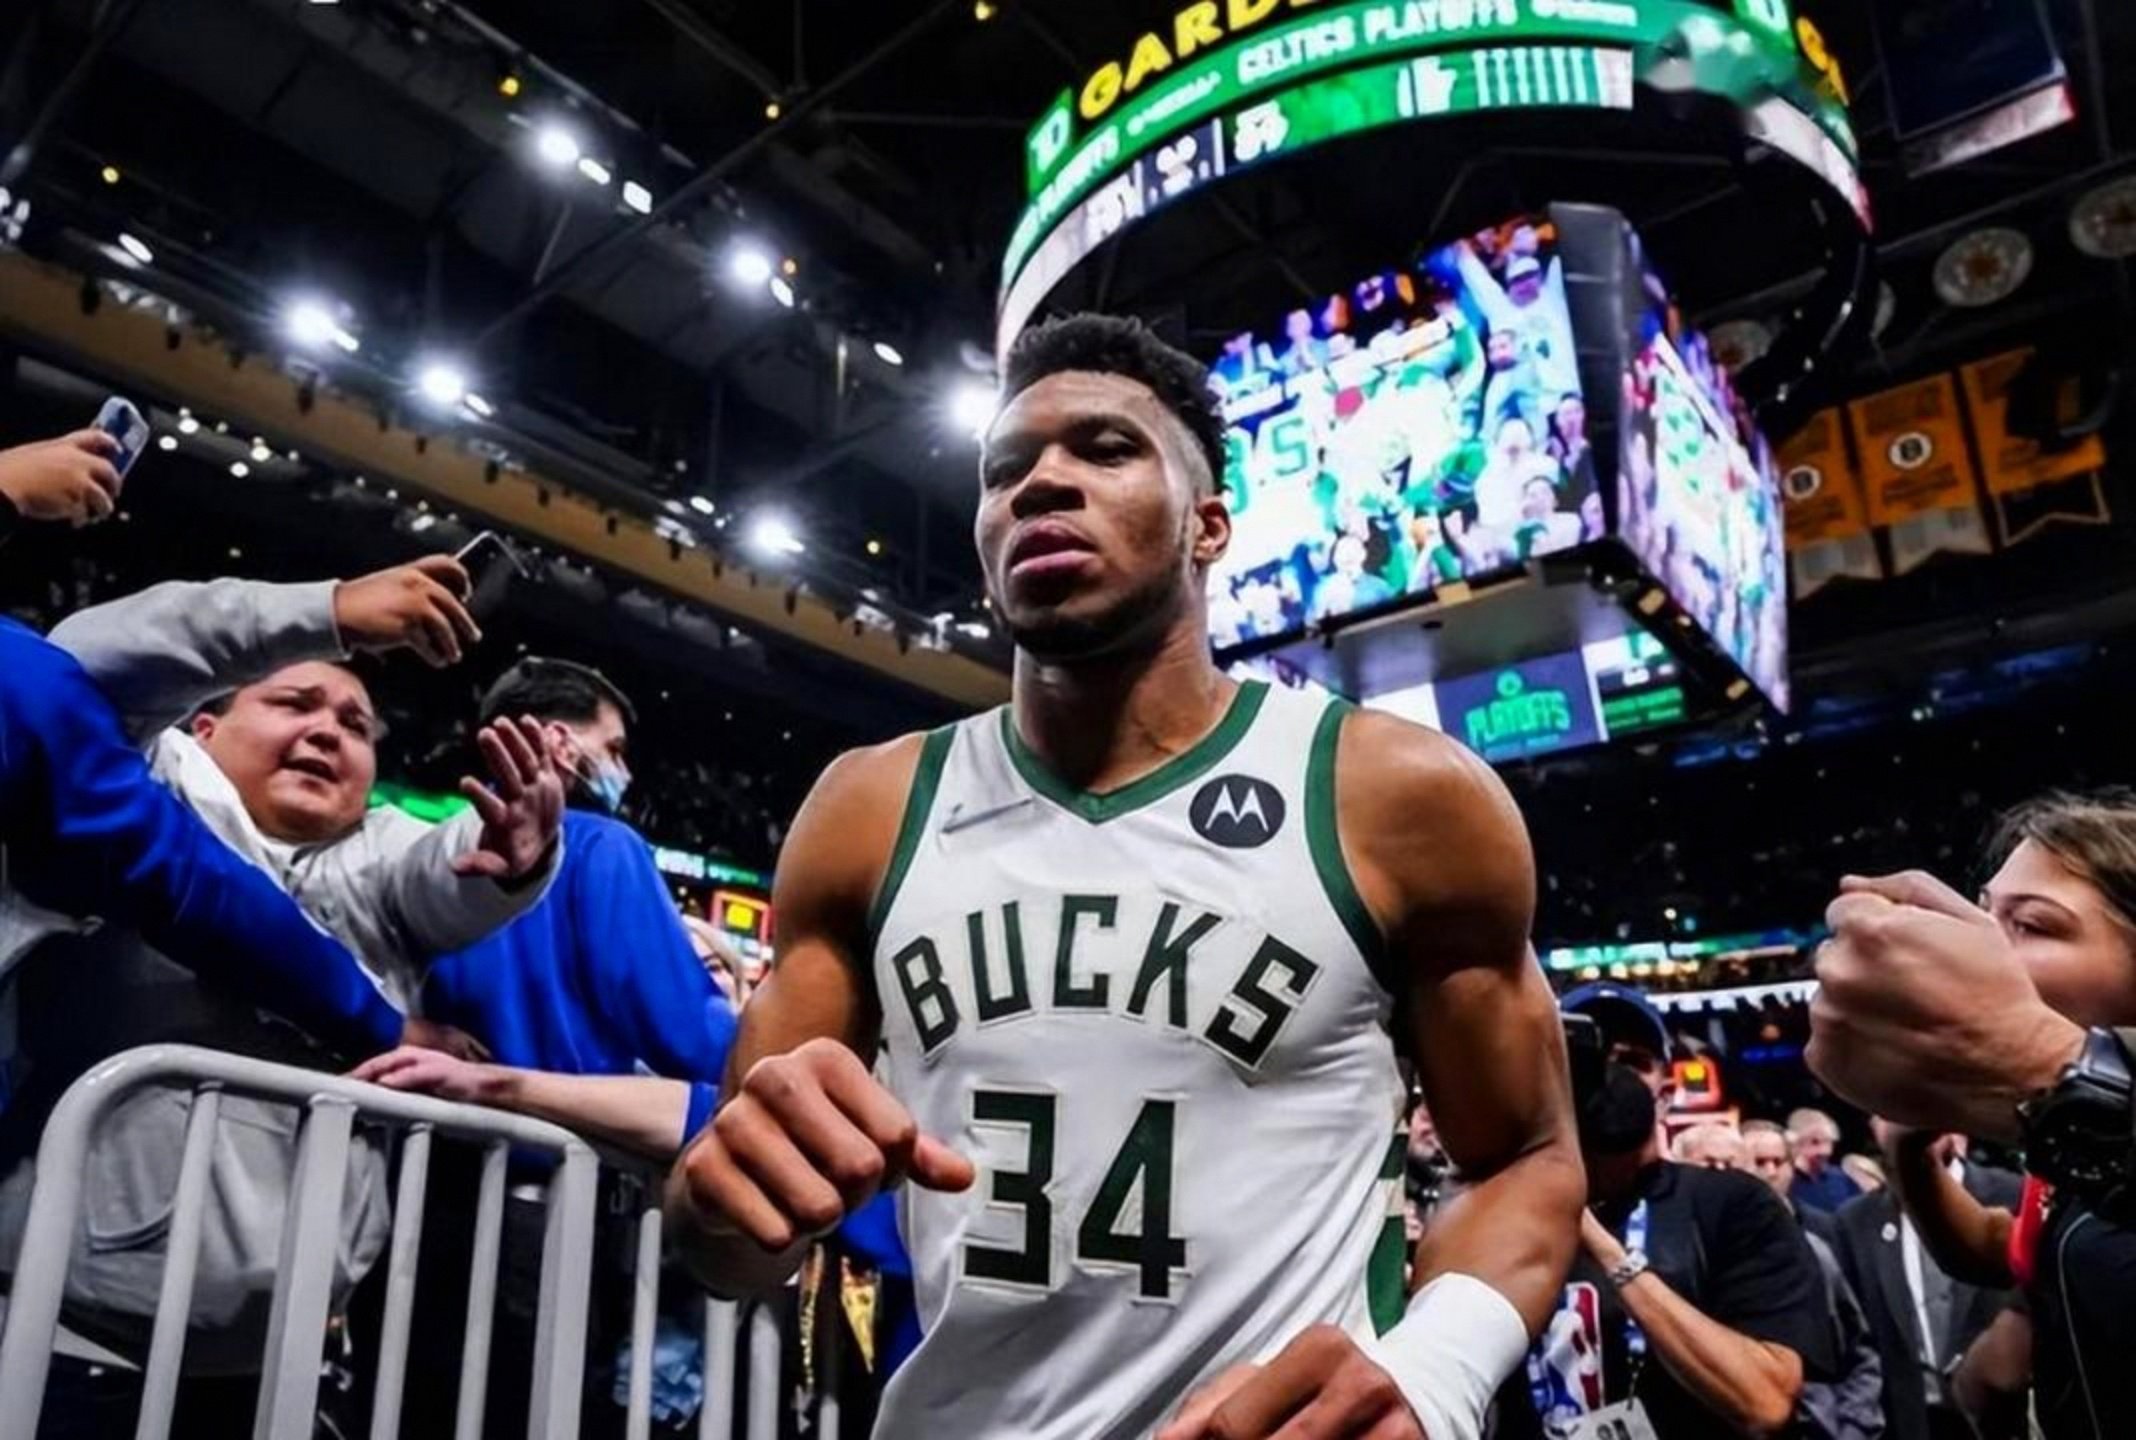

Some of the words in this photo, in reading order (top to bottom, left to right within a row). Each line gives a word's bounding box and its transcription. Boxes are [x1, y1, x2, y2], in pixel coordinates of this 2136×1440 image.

[1079, 0, 1320, 120] GARD
[891, 893, 1320, 1072] BUCKS
[960, 1088, 1190, 1300] 34
